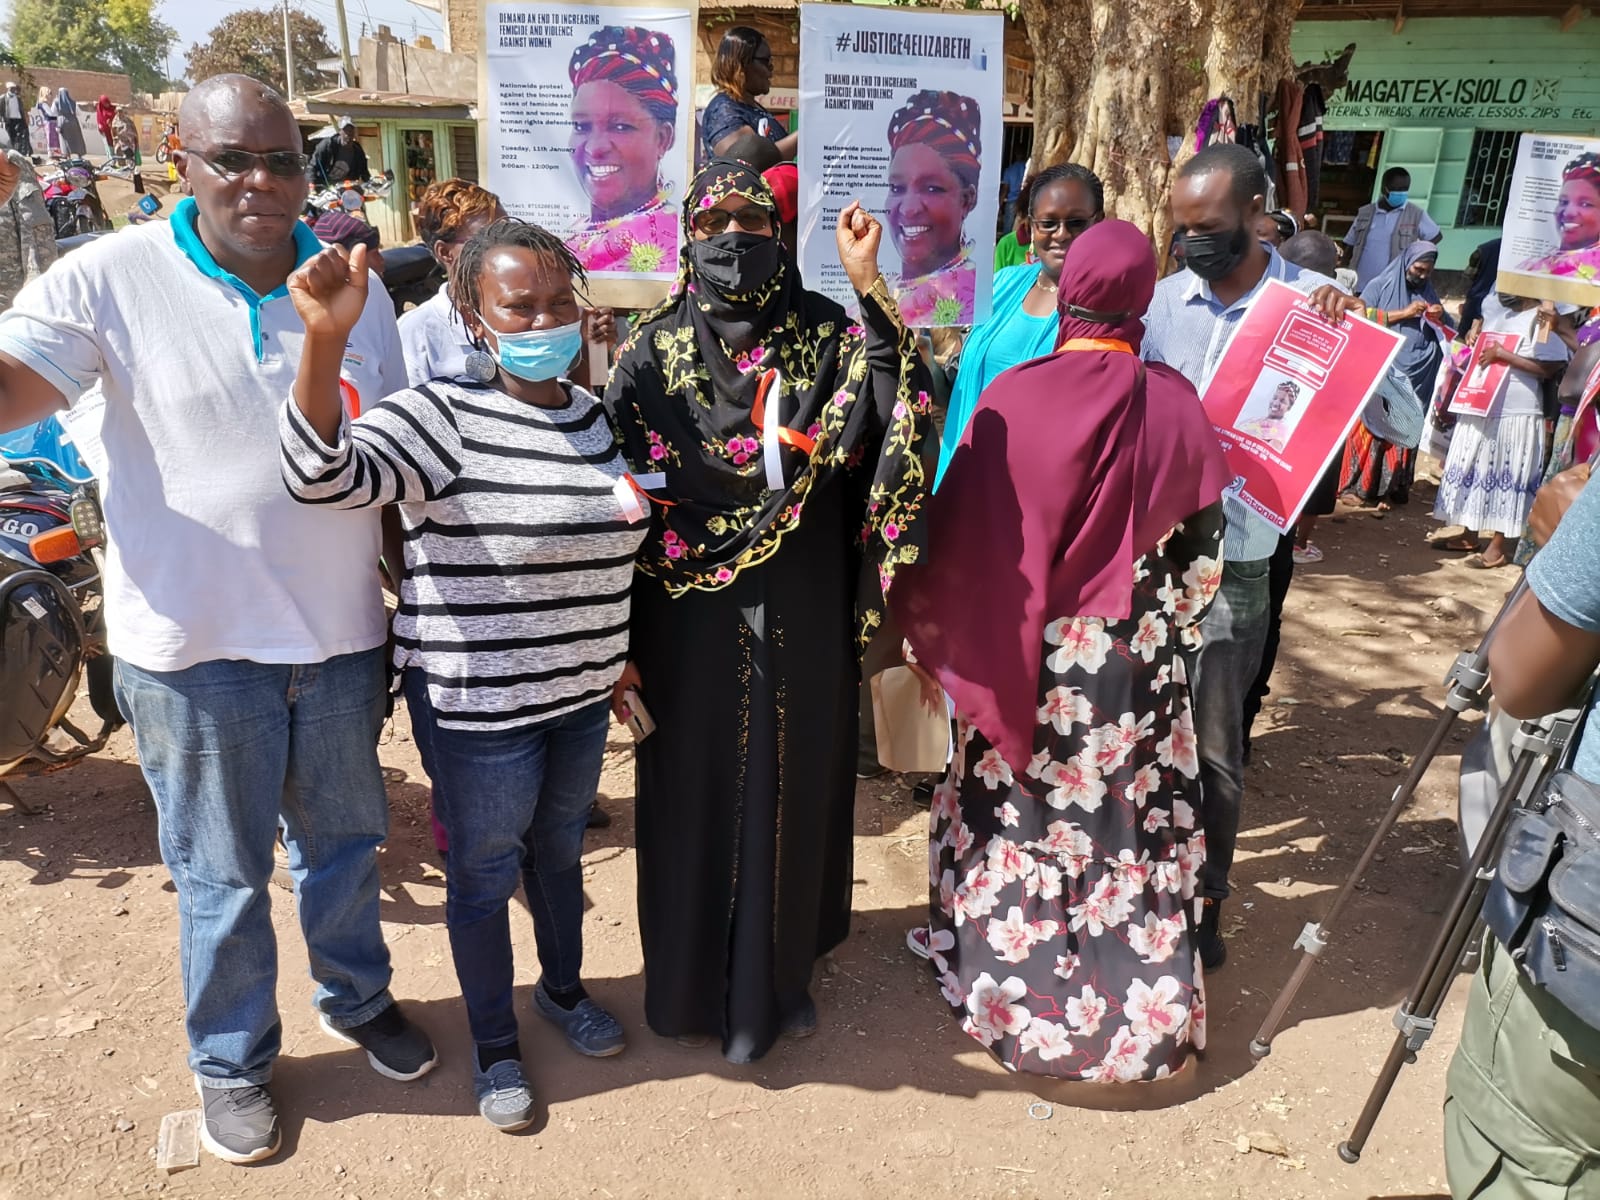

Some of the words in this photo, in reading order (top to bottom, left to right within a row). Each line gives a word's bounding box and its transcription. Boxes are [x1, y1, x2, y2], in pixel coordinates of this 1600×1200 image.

[499, 12, 526, 24] DEMAND
[527, 13, 537, 24] AN
[538, 13, 550, 24] END
[551, 14, 560, 25] TO
[561, 14, 600, 25] INCREASING
[499, 25, 528, 35] FEMICIDE
[530, 25, 543, 36] AND
[544, 25, 573, 36] VIOLENCE
[499, 36, 527, 47] AGAINST
[528, 37, 552, 48] WOMEN
[836, 30, 971, 59] #JUSTICE4ELIZABETH
[824, 73, 850, 85] DEMAND
[851, 75, 860, 85] AN
[861, 75, 873, 86] END
[874, 76, 881, 87] TO
[882, 76, 918, 89] INCREASING
[824, 86, 852, 97] FEMICIDE
[853, 87, 866, 98] AND
[867, 88, 893, 99] VIOLENCE
[1344, 79, 1527, 104] MAGATEX-ISIOLO
[770, 96, 796, 106] CAFE
[824, 98, 850, 110] AGAINST
[852, 100, 874, 110] WOMEN
[1325, 105, 1371, 117] ATERIALS
[1530, 107, 1560, 119] ZIPS
[1571, 108, 1593, 119] Etc
[549, 146, 577, 154] January
